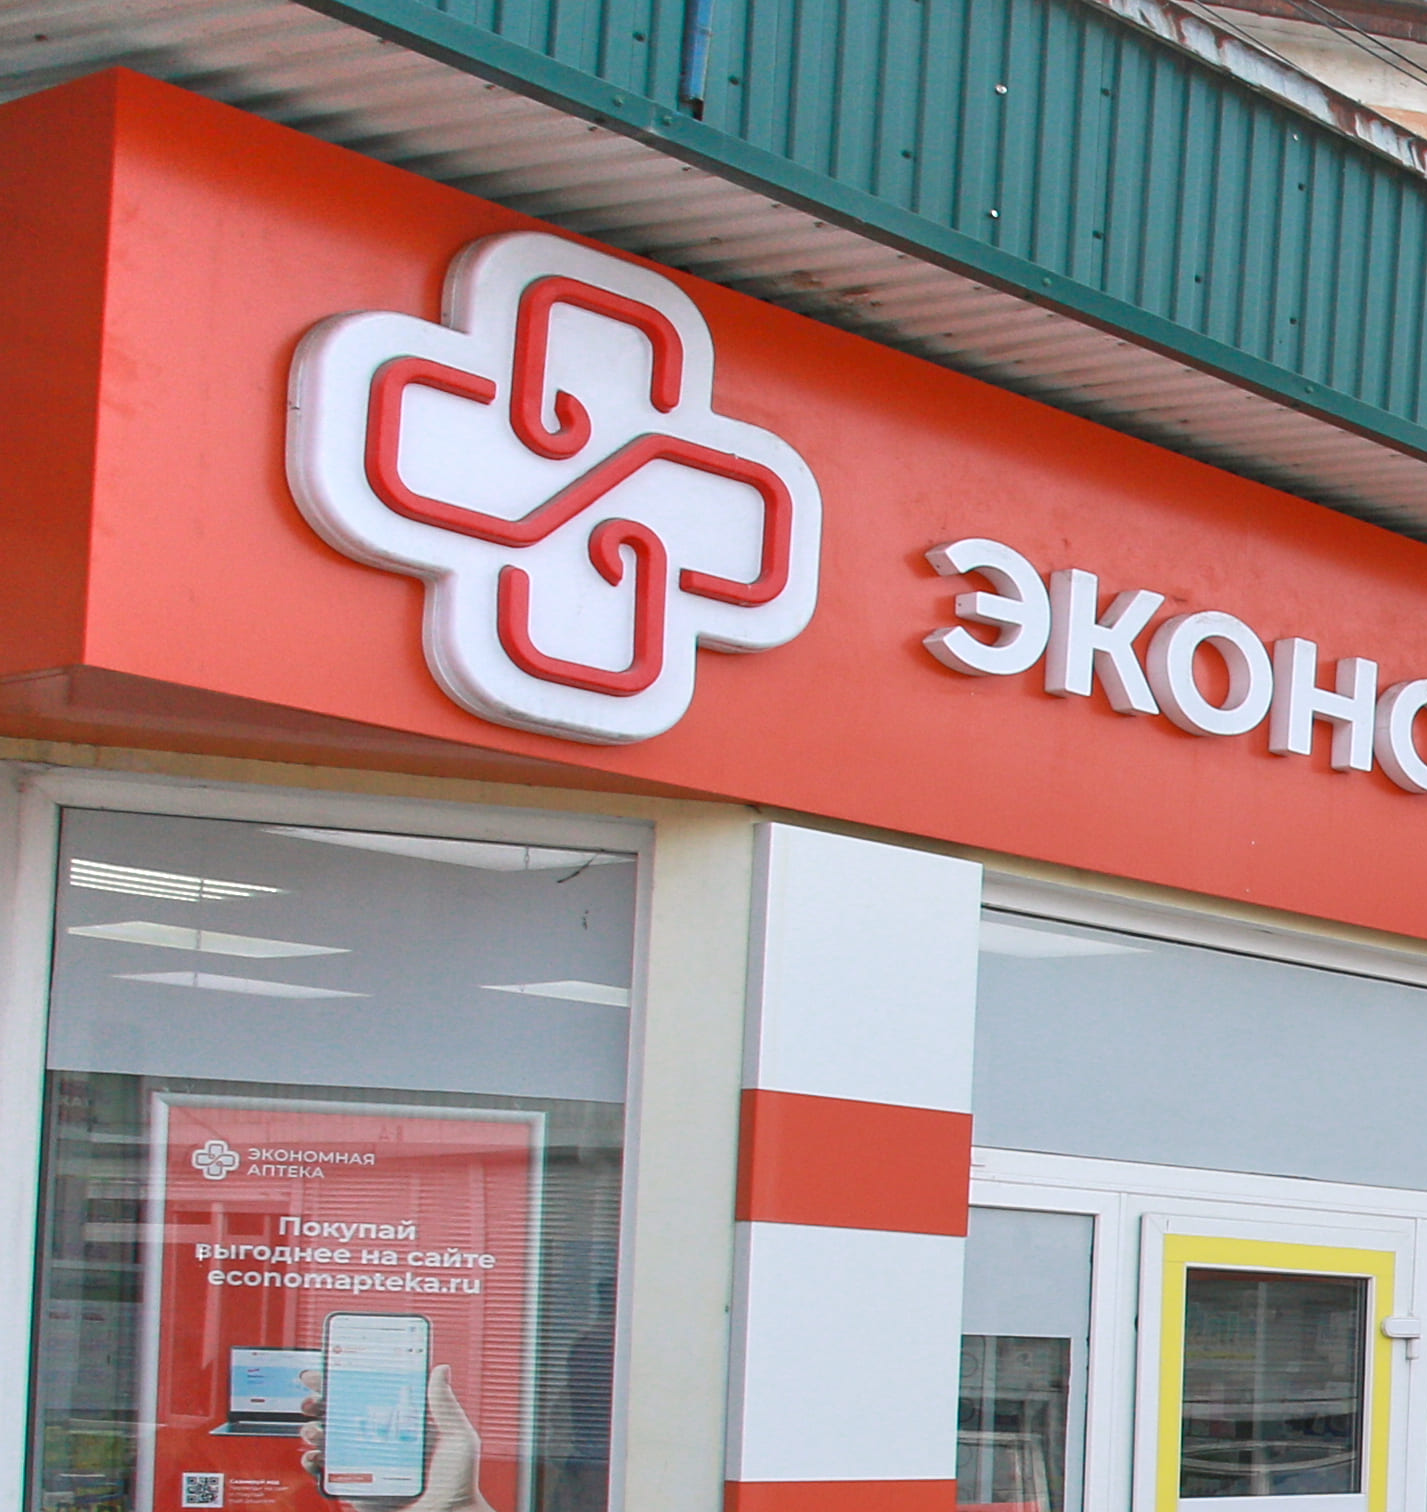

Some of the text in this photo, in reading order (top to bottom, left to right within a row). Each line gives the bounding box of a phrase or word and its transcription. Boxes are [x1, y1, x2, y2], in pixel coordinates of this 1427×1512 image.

[248, 1148, 376, 1167] ЭКОНОМНАЯ
[247, 1165, 325, 1179] АПТЕКА
[278, 1216, 417, 1243] Покупай
[194, 1243, 497, 1270] выгоднее на сайте
[207, 1269, 483, 1295] economapteka.ru
